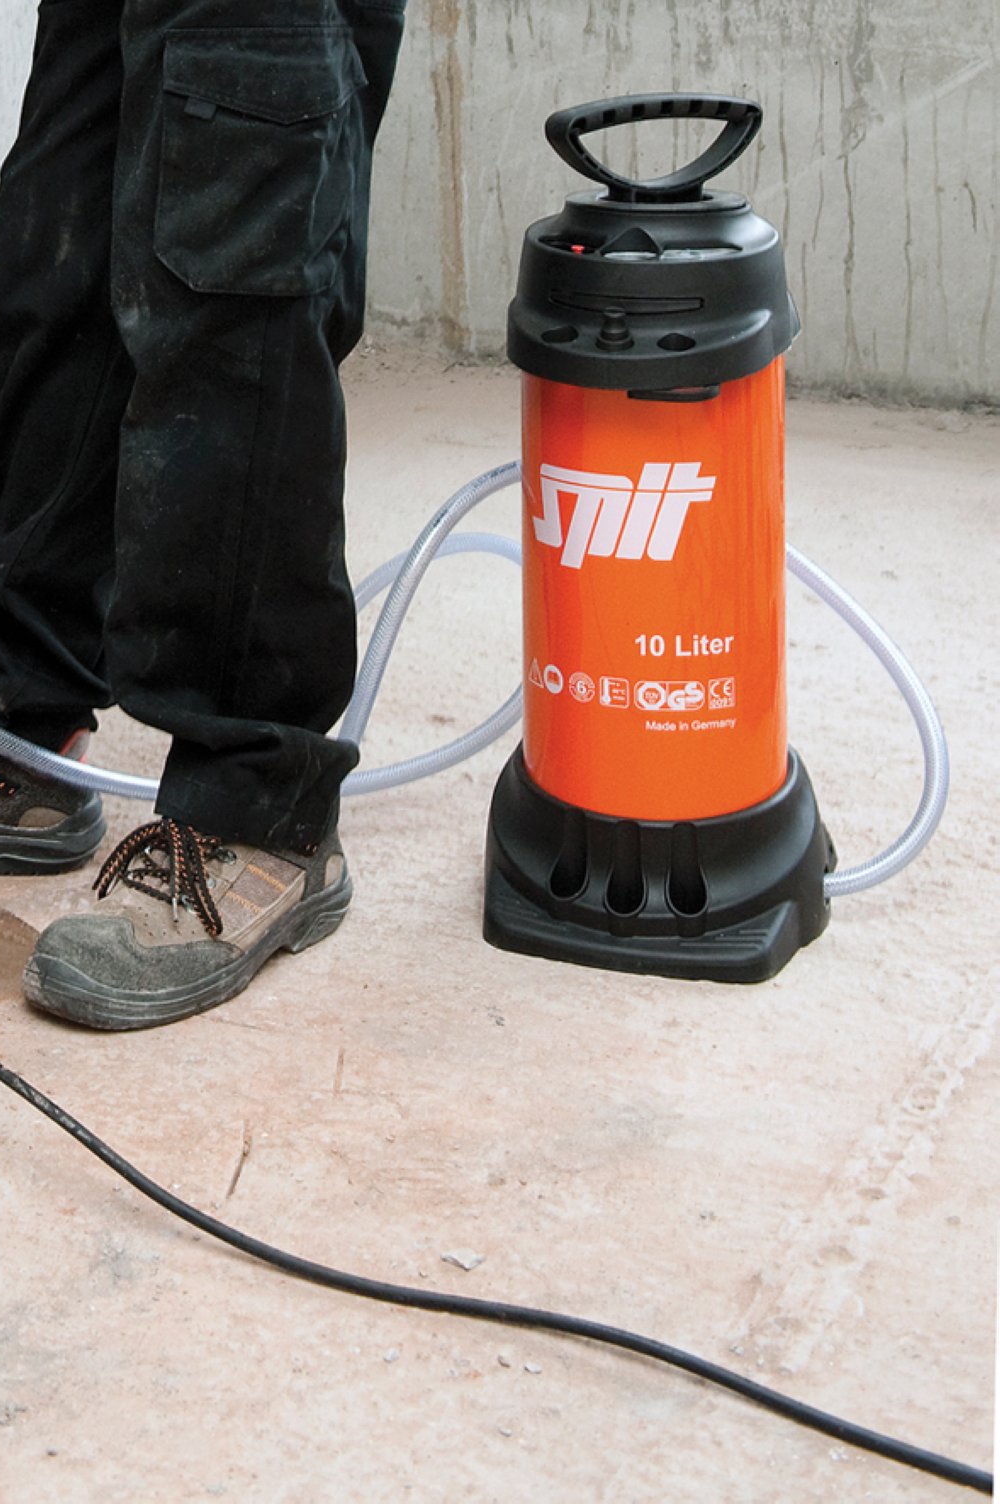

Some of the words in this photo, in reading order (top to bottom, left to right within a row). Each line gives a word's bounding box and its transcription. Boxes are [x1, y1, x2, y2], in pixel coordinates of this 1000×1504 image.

[635, 634, 665, 657] 10
[675, 634, 735, 657] Liter
[644, 719, 677, 732] Made
[679, 720, 689, 731] in
[690, 718, 737, 731] Germany
